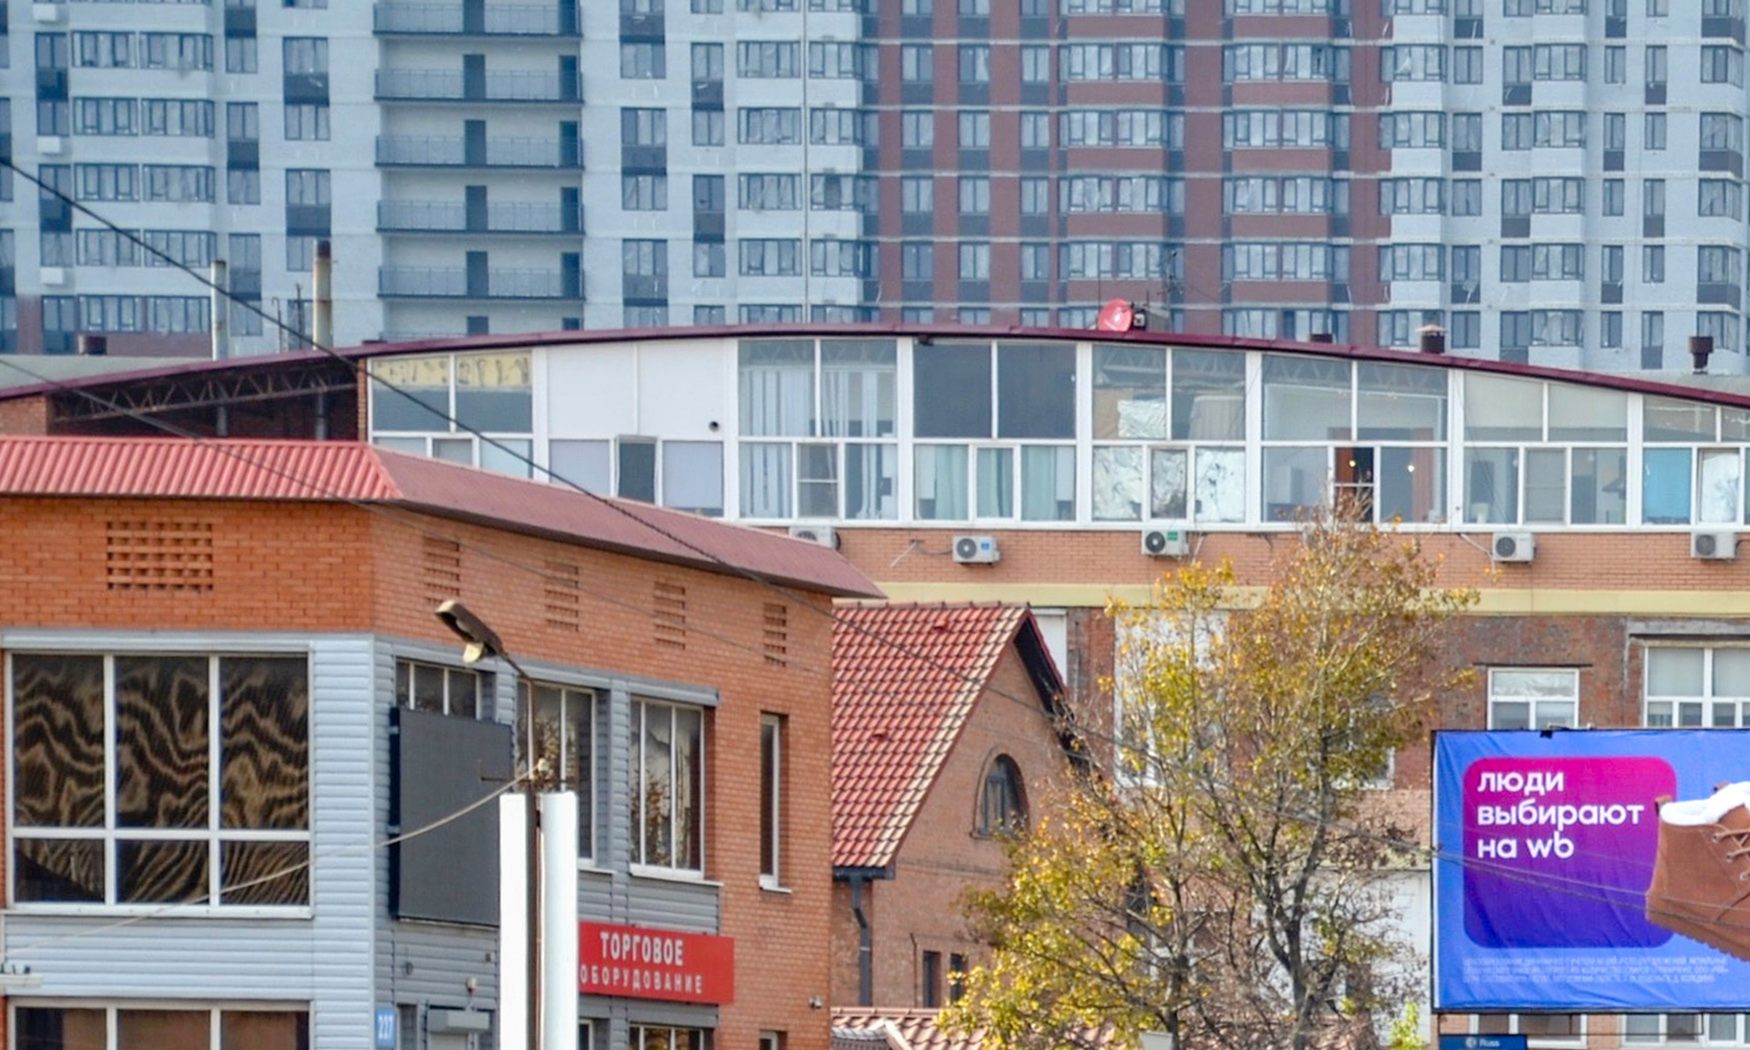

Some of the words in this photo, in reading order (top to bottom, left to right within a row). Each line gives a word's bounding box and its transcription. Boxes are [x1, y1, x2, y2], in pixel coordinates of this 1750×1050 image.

[1477, 772, 1564, 796] люди
[1477, 798, 1645, 832] выбирают
[1477, 838, 1518, 859] на
[1526, 831, 1574, 859] wb
[600, 931, 684, 966] ТОРГОВОЕ
[580, 964, 703, 994] ОБОРУДОВАНИЕ
